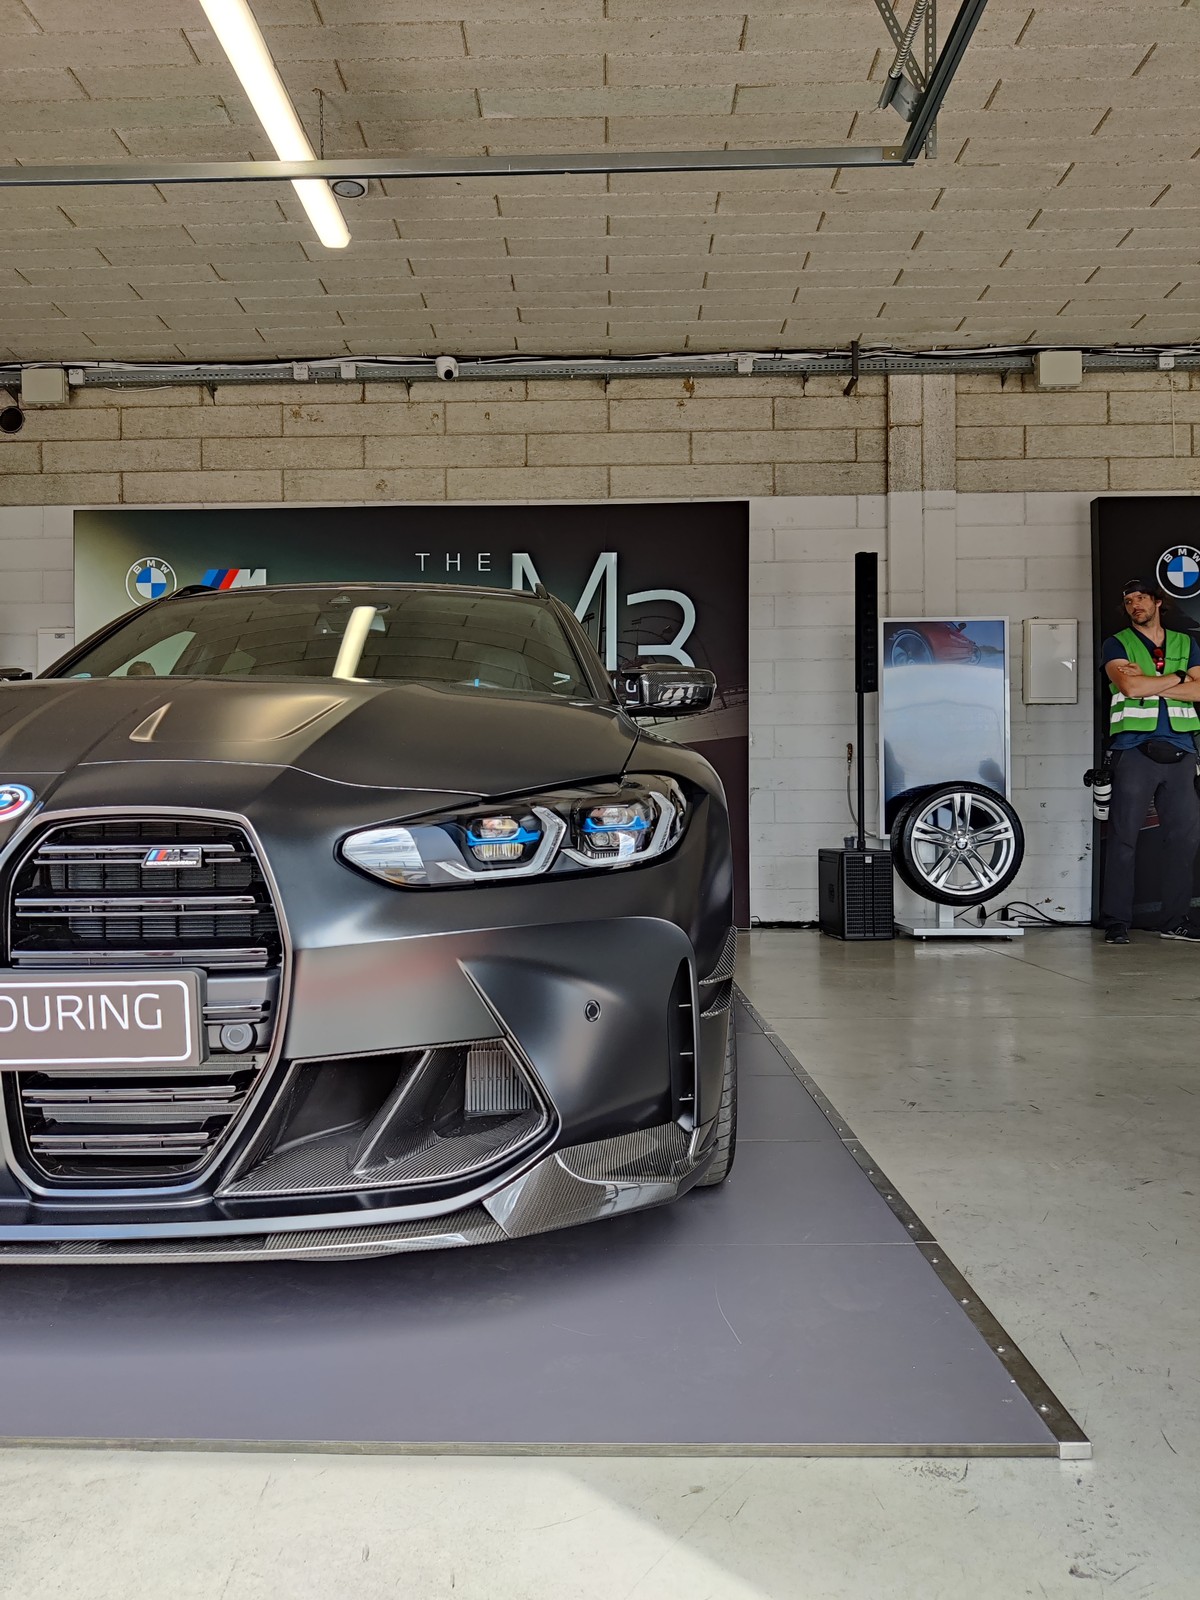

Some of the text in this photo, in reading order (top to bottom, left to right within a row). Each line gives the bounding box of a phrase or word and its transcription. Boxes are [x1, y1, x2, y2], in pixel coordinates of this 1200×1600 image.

[415, 551, 696, 703] THE M3
[0, 993, 162, 1031] OURING
